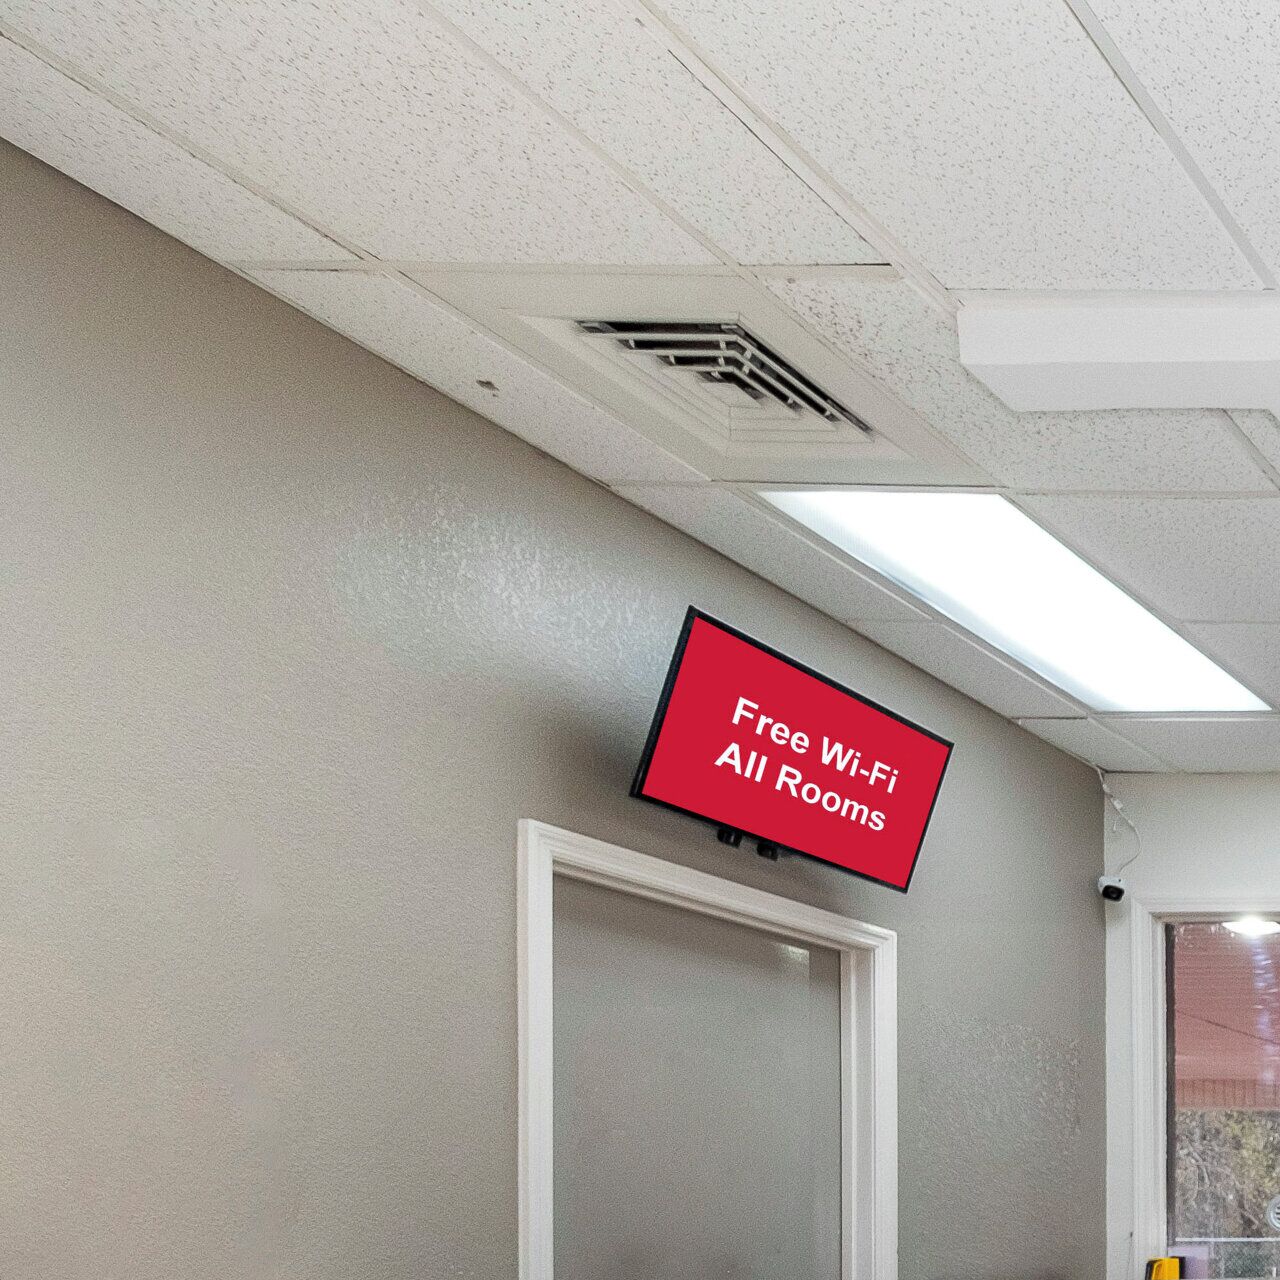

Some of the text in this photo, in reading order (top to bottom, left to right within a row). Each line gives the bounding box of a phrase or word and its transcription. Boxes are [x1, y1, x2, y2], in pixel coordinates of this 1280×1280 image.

[715, 743, 886, 830] All Rooms
[732, 697, 899, 793] Free Wi-Fi
